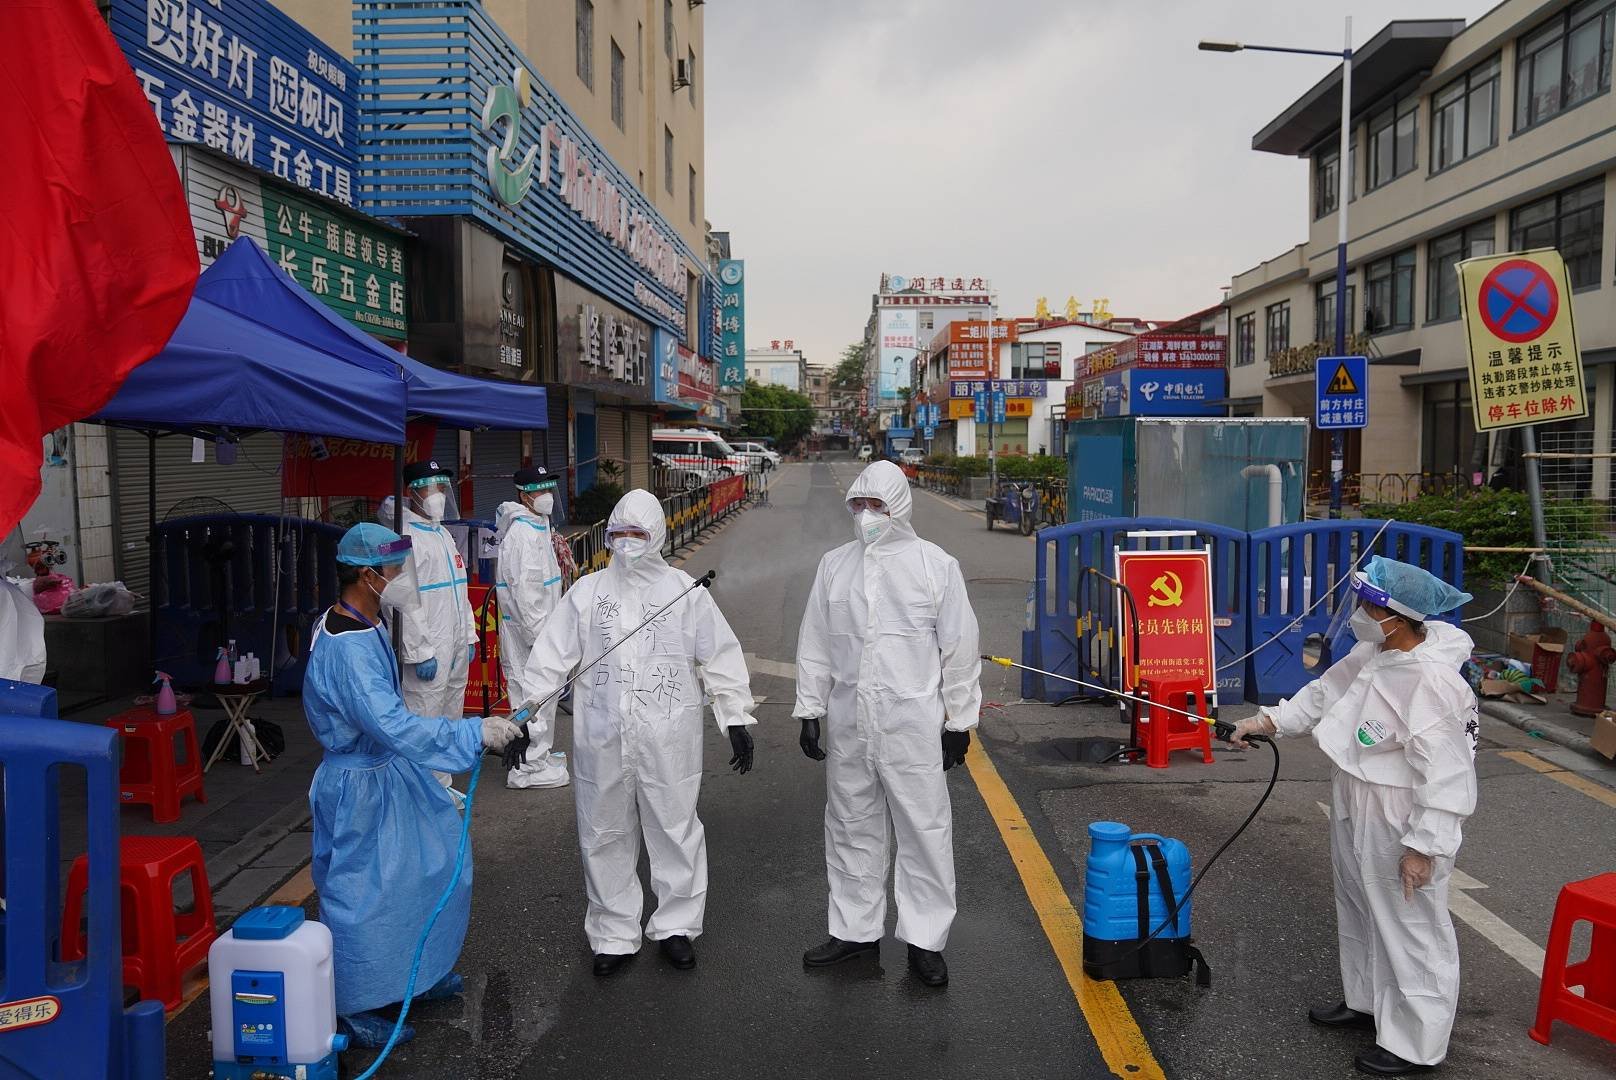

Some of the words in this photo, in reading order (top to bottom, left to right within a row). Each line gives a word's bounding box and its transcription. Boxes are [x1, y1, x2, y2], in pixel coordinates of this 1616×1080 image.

[134, 67, 256, 165] 五金器材
[270, 135, 353, 208] 五金工具
[279, 243, 404, 316] 长乐五金店
[770, 339, 794, 350] 客房
[1488, 342, 1562, 367] 温馨提示
[1482, 361, 1574, 385] 执勤路段禁止停车
[1164, 382, 1204, 395] 中国电信
[1483, 375, 1576, 399] 违者交警抄牌处理
[1320, 398, 1364, 411] 前方村庄
[1488, 394, 1576, 422] 停车位除外
[1320, 411, 1364, 424] 减速慢行
[1131, 618, 1203, 635] 党员先锋岗
[0, 1002, 51, 1025] 爱得乐
